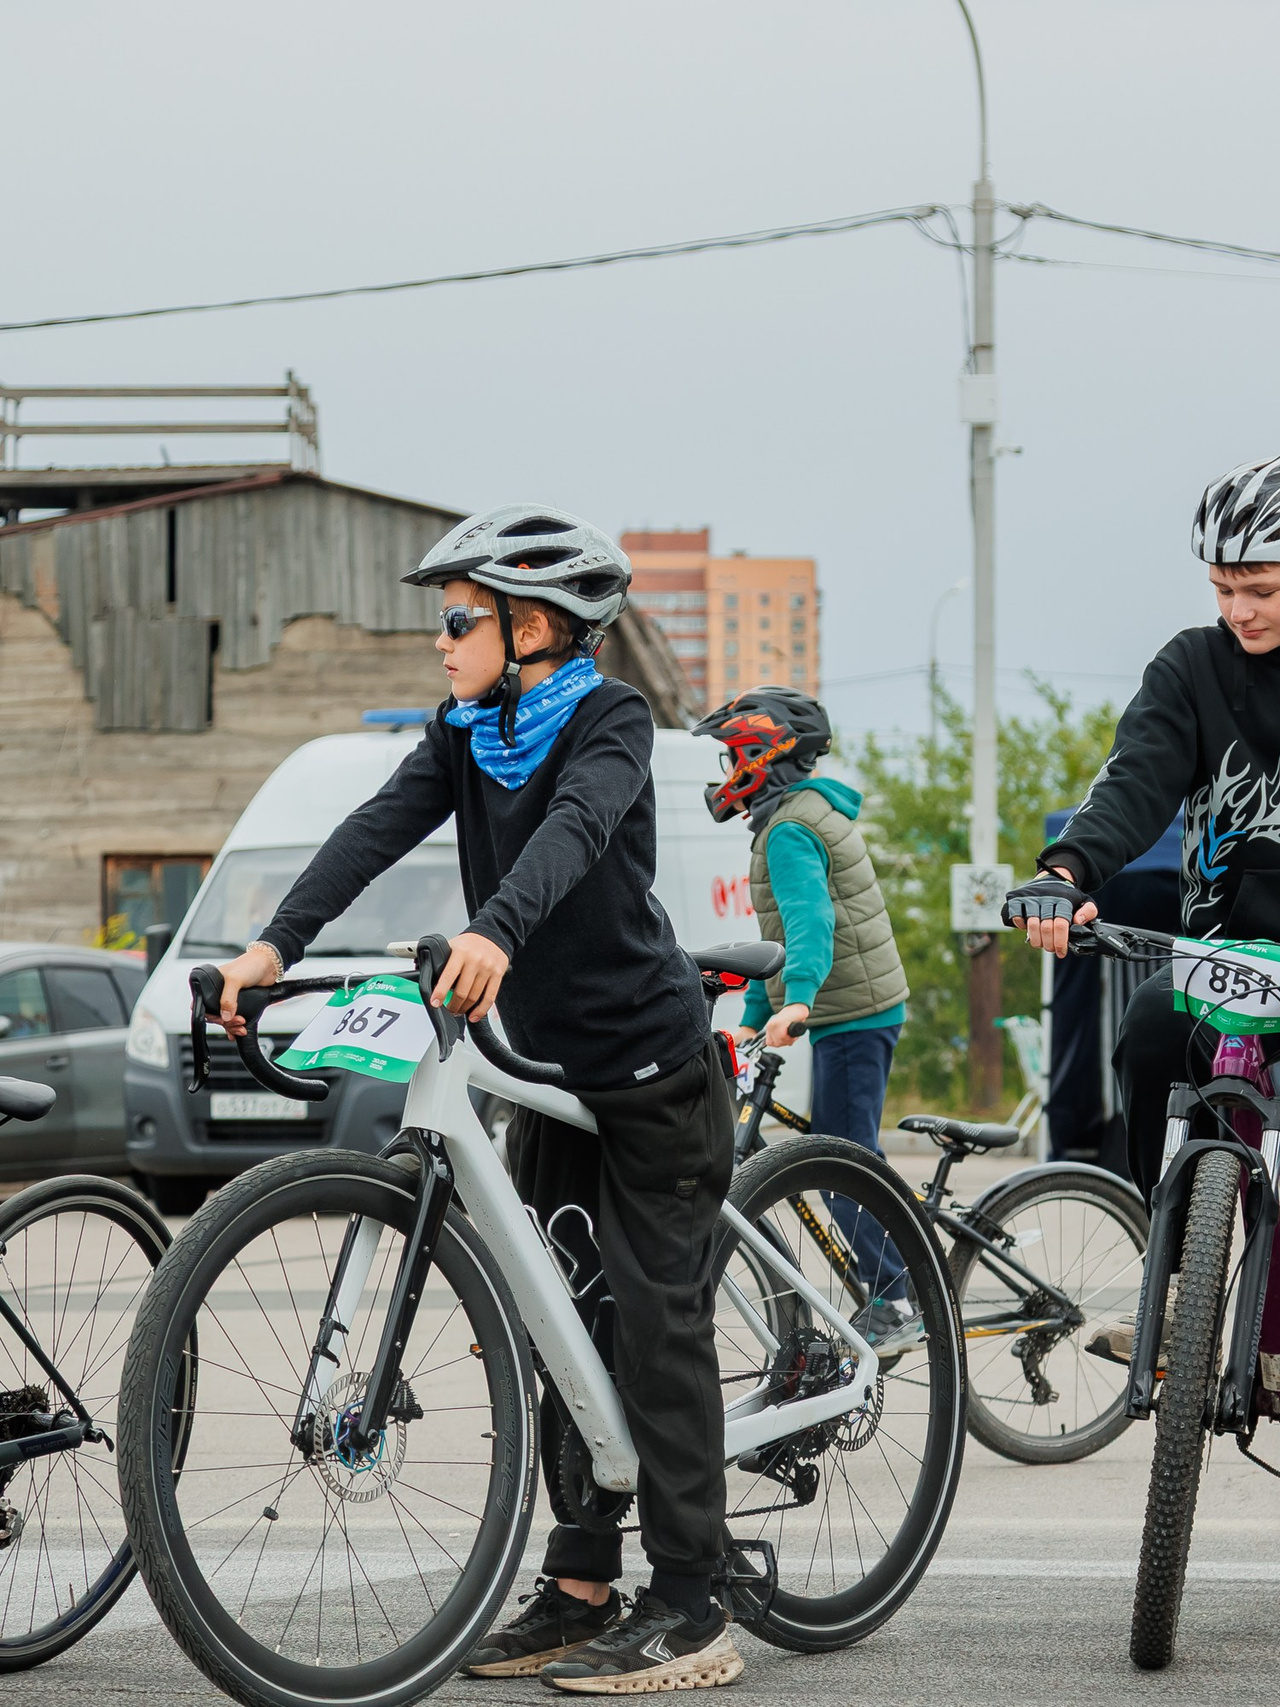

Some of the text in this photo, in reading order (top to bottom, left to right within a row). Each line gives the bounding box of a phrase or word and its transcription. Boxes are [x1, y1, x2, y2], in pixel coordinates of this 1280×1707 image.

[453, 521, 494, 550] KED
[567, 555, 608, 569] KED
[1208, 964, 1273, 1006] 851
[333, 1007, 401, 1038] 867
